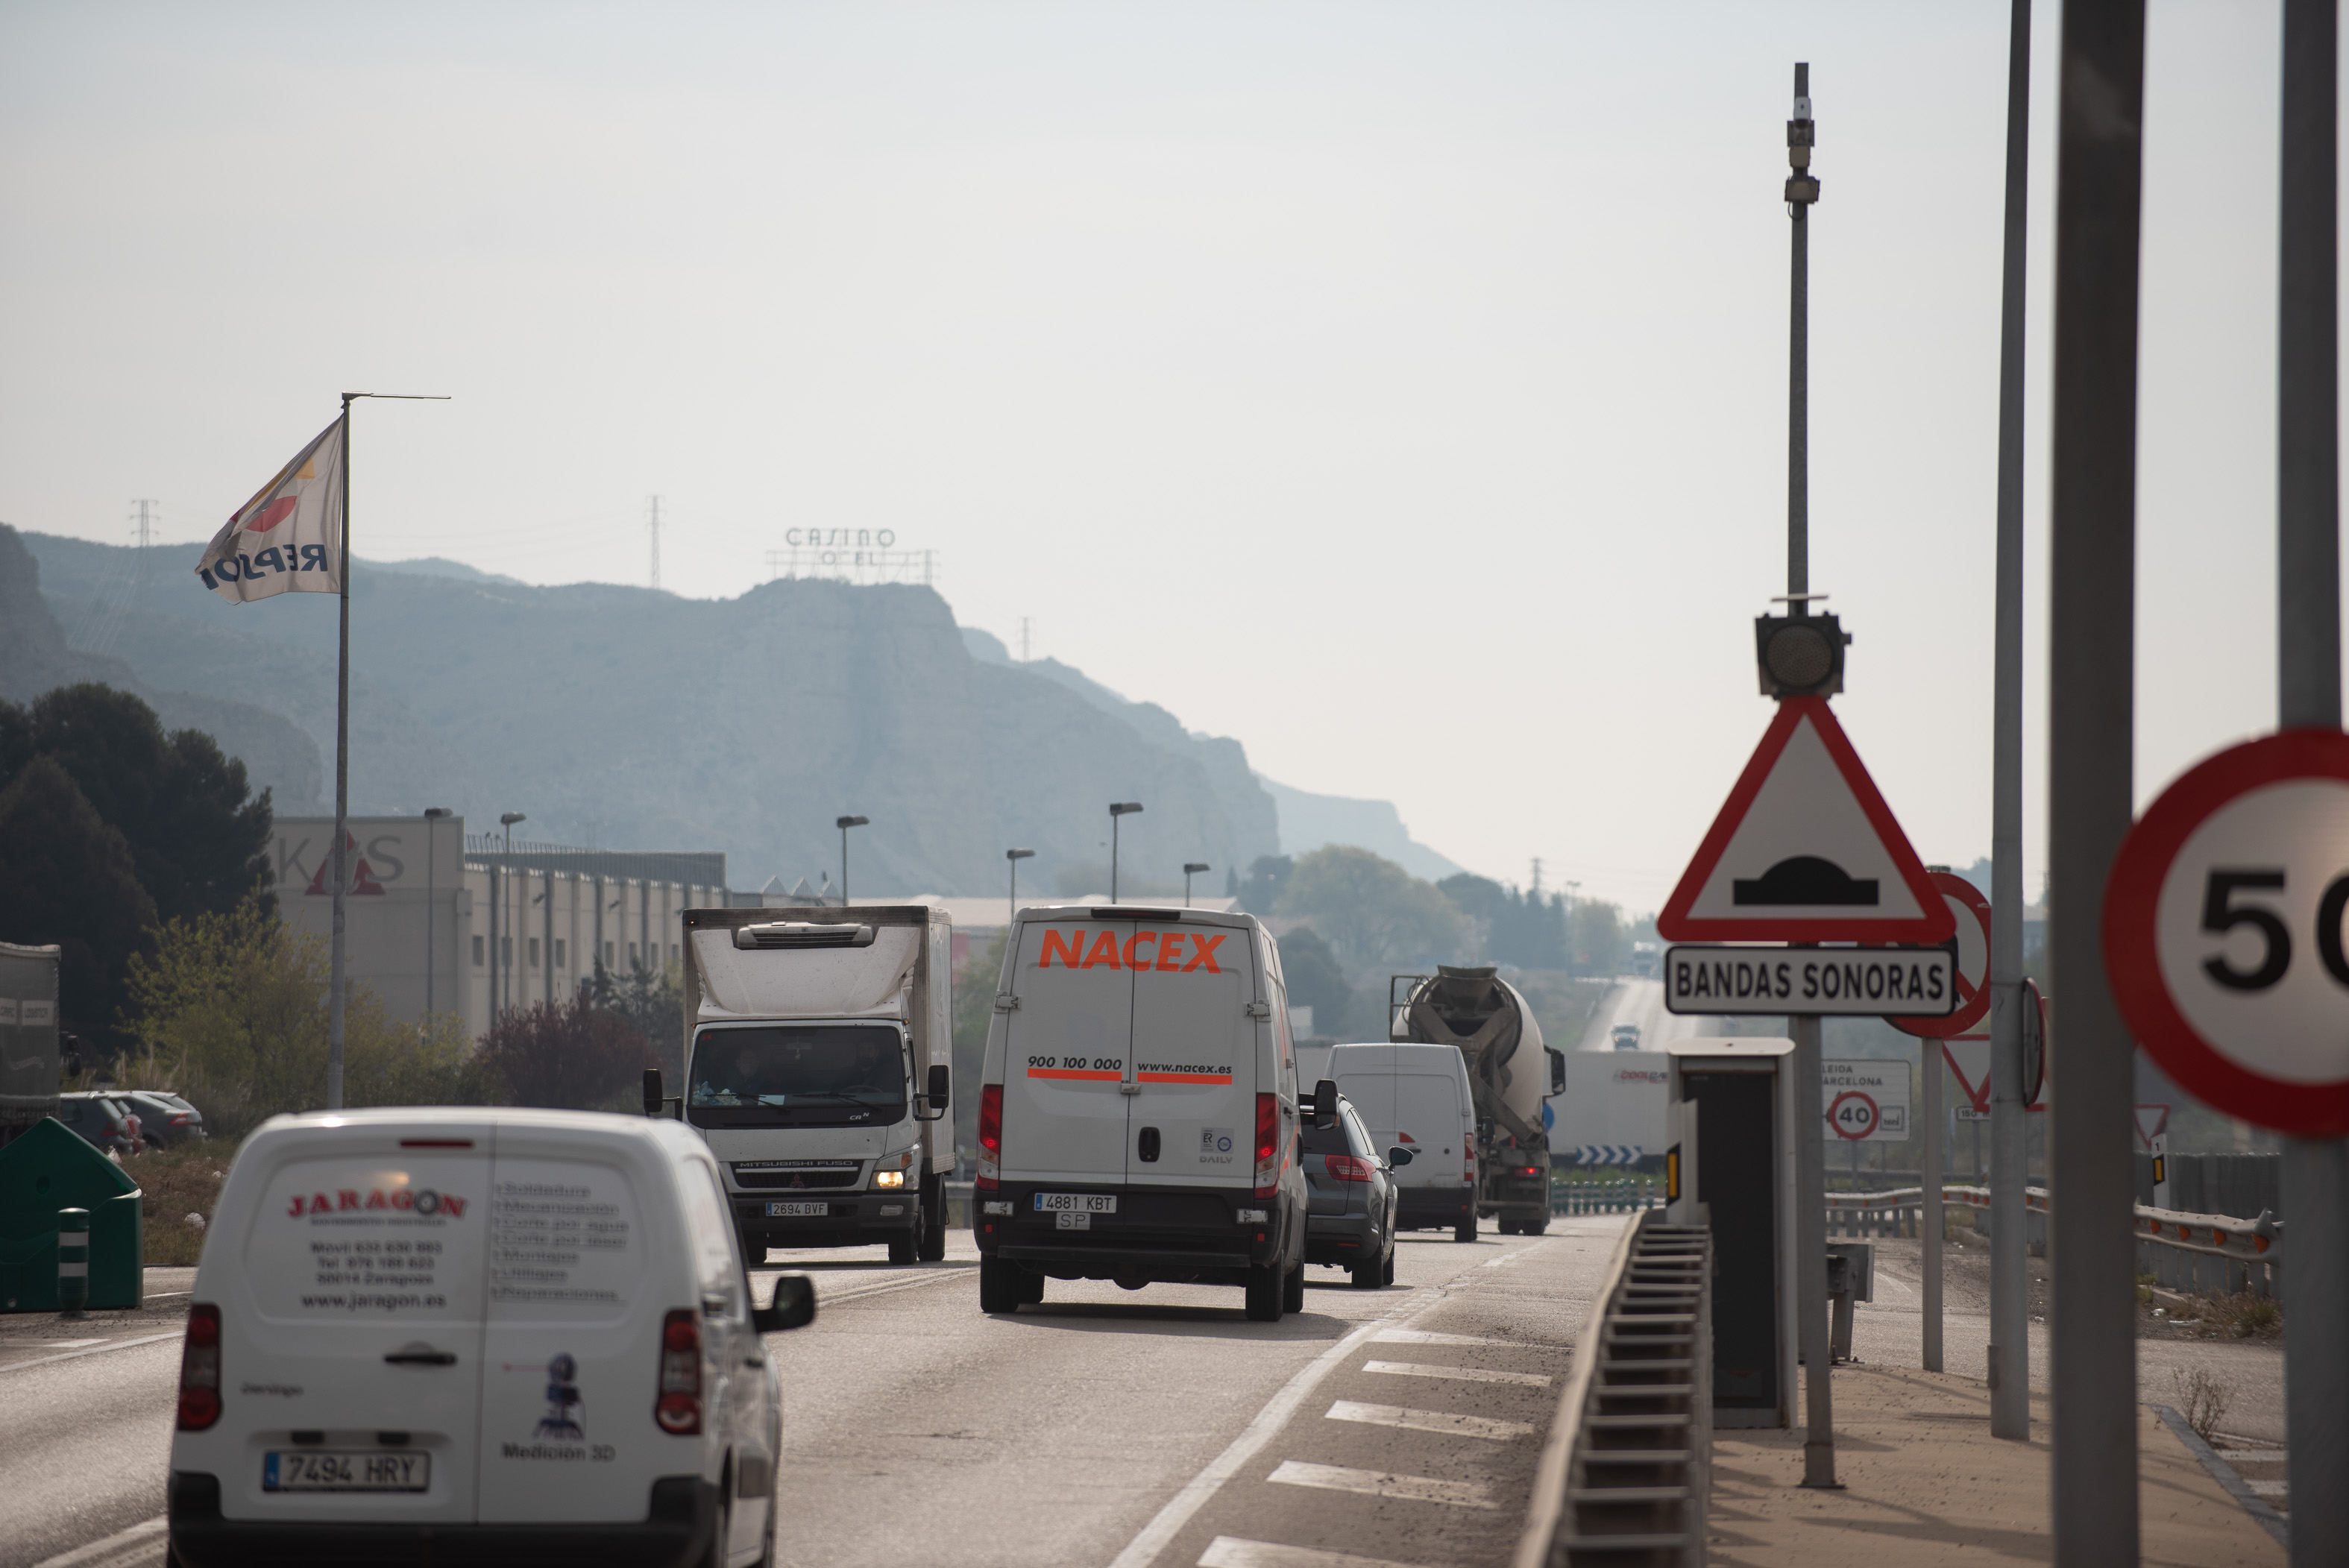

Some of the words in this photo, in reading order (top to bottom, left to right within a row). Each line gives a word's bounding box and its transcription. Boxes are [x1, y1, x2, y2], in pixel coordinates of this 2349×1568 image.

[786, 528, 895, 547] CASINO
[1039, 929, 1227, 974] NACEX
[1676, 962, 1791, 999] BANDAS
[1802, 963, 1944, 1000] SONORAS
[1028, 1056, 1055, 1068] 900
[1063, 1057, 1087, 1069] 100
[1094, 1058, 1122, 1070] 000
[1138, 1062, 1232, 1074] www.nacex.es
[1823, 1077, 1883, 1086] ARCELONA
[1839, 1106, 1870, 1123] 40
[1961, 1109, 1977, 1118] 150
[286, 1188, 470, 1221] JARAGON
[773, 1204, 801, 1215] 2694
[805, 1203, 826, 1214] DVF
[1046, 1196, 1078, 1209] 4881
[1087, 1197, 1112, 1210] KBT
[1060, 1214, 1086, 1227] SP
[301, 1291, 447, 1312] www.jaragon.es
[590, 1444, 617, 1462] 3D
[287, 1455, 353, 1482] 7494
[365, 1457, 415, 1483] HRY
